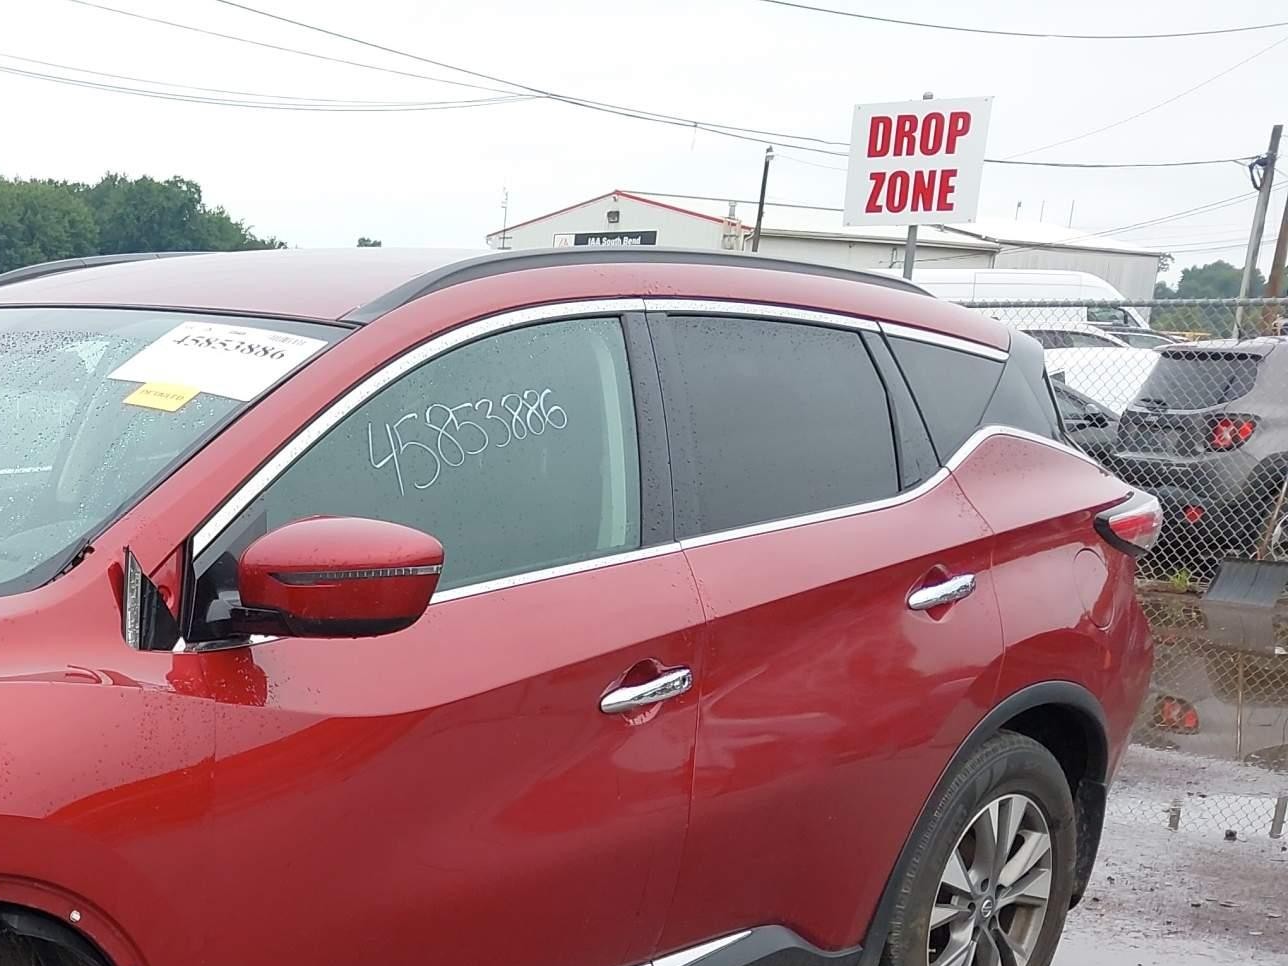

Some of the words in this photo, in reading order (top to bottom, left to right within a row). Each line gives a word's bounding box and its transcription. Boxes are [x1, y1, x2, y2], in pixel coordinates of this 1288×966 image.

[867, 111, 972, 158] DROP
[865, 168, 958, 213] ZONE
[588, 237, 601, 246] IAA
[602, 236, 622, 246] South
[623, 236, 641, 245] Bend
[173, 334, 285, 361] 45853886
[368, 389, 568, 496] 45853886
